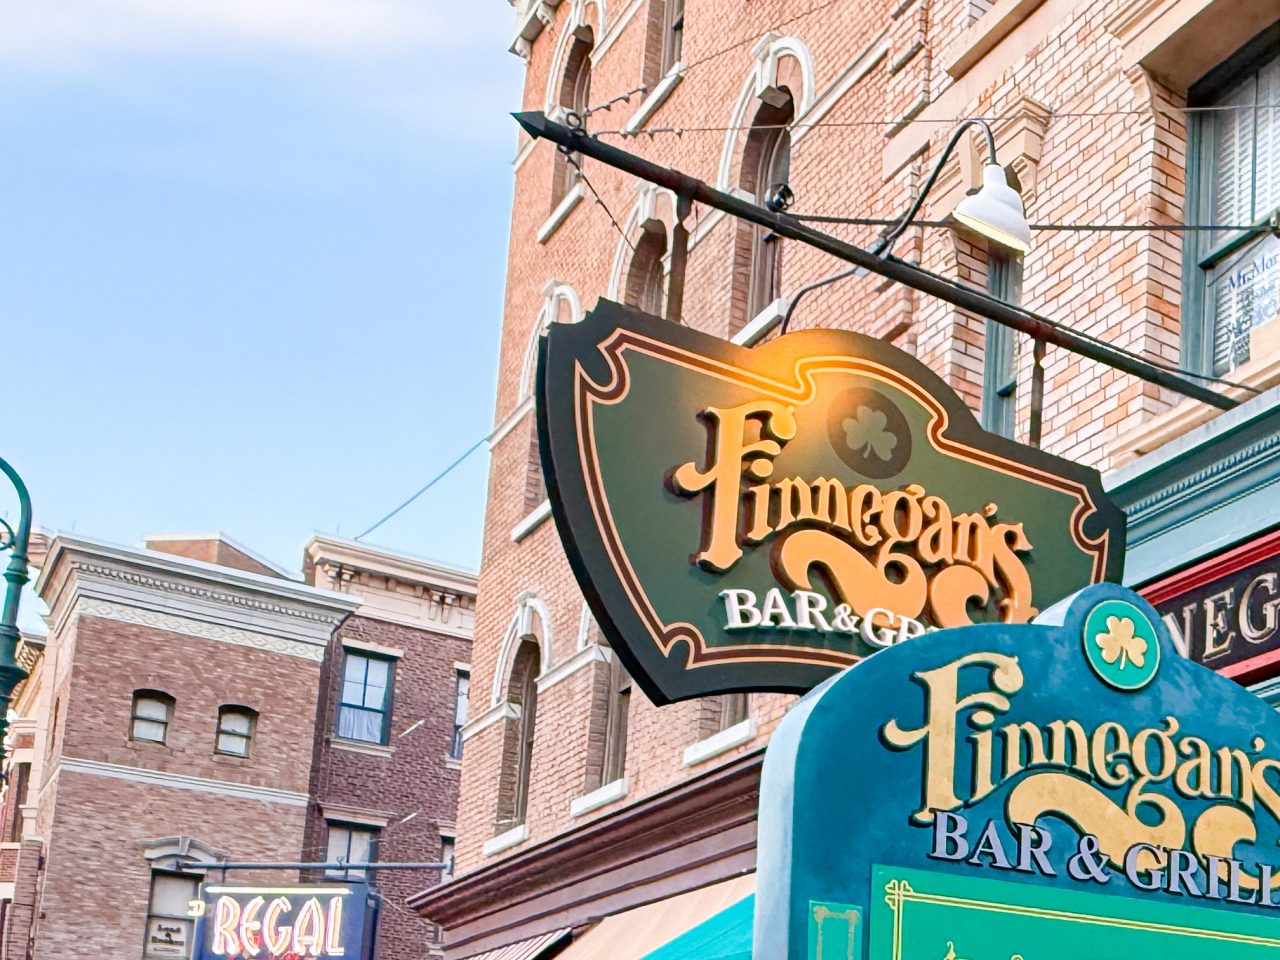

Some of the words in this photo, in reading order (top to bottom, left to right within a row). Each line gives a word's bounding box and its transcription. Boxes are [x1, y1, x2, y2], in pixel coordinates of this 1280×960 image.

[672, 400, 1038, 624] Finnegan's
[929, 812, 1057, 876] BAR
[1068, 833, 1111, 884] &
[211, 895, 345, 956] REGAL
